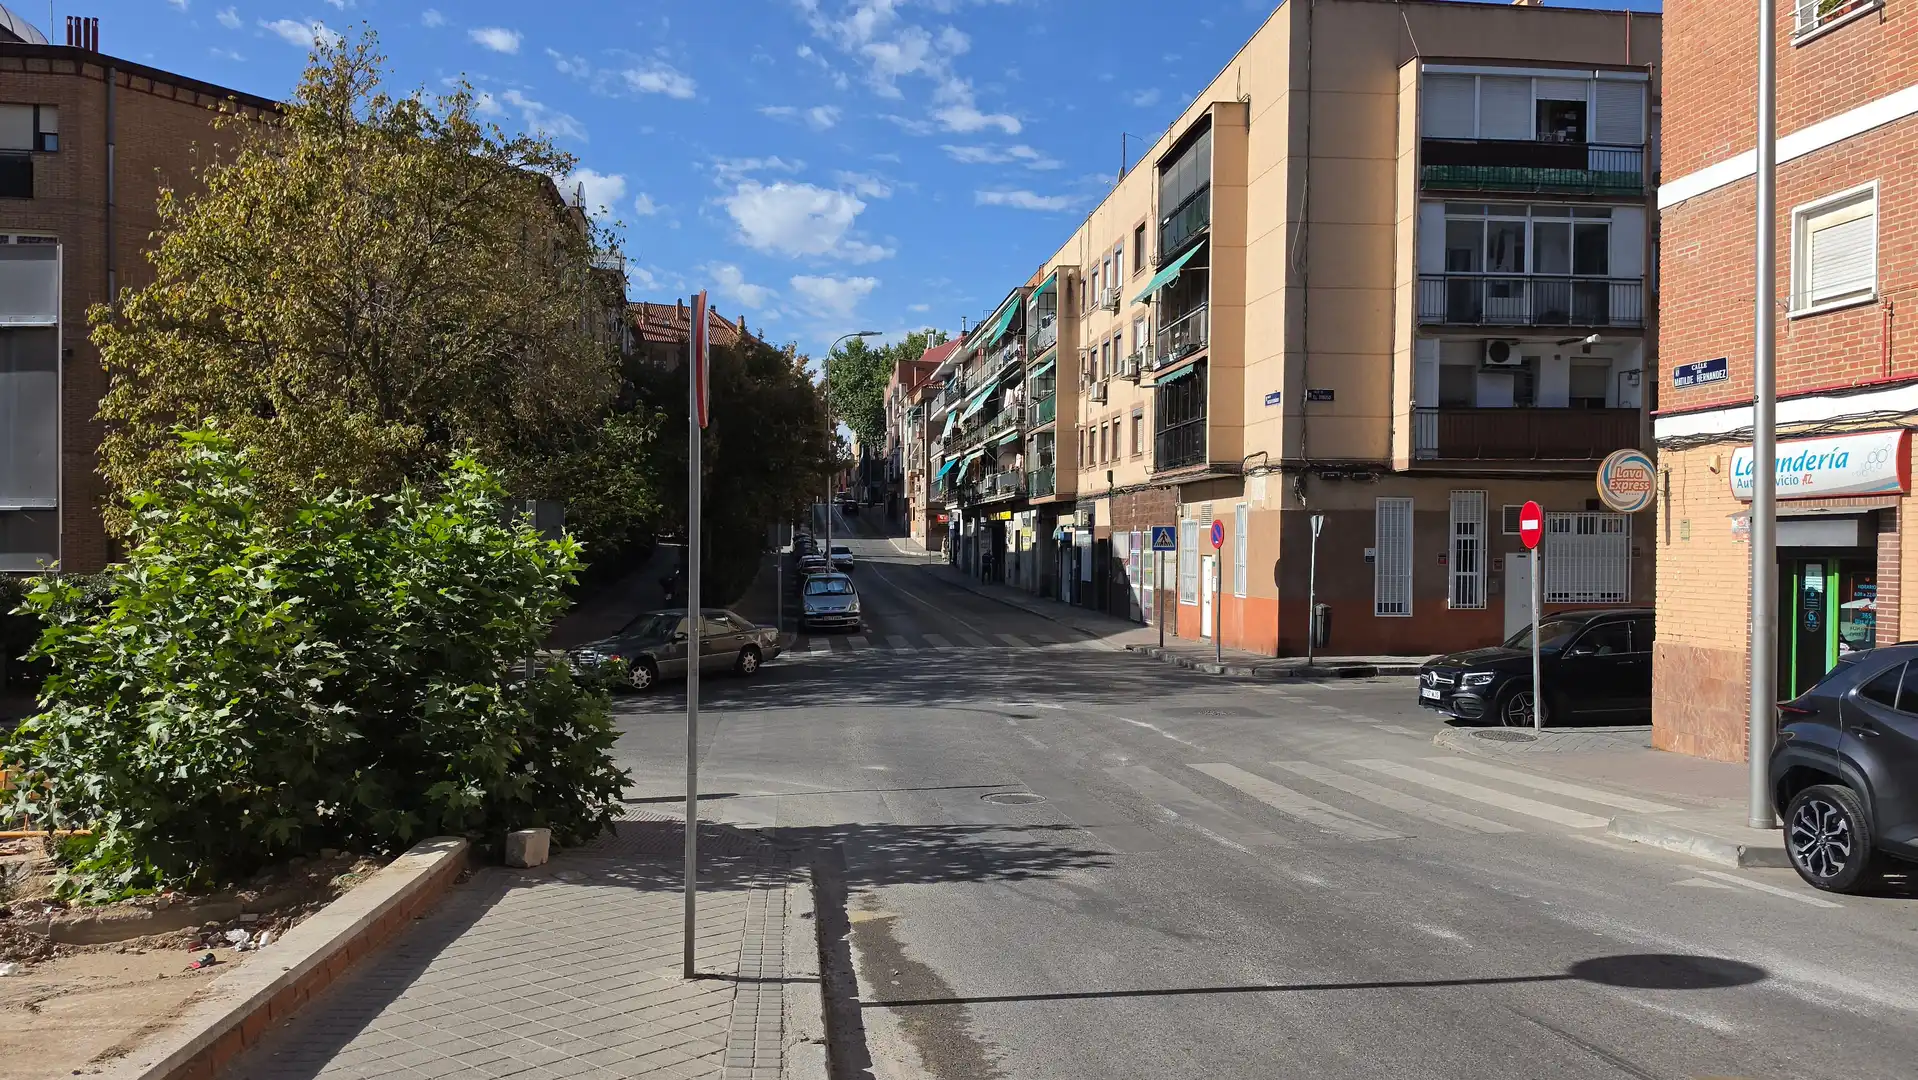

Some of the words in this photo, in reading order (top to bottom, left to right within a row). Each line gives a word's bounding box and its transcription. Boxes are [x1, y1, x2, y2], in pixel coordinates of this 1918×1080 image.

[1691, 362, 1708, 371] CALLE
[1674, 375, 1694, 387] MATILDE
[1696, 369, 1726, 384] HERNANDEZ
[1735, 446, 1850, 476] Landería
[1616, 466, 1643, 479] Lava
[1609, 478, 1651, 494] Express
[1736, 474, 1799, 489] Autvicio
